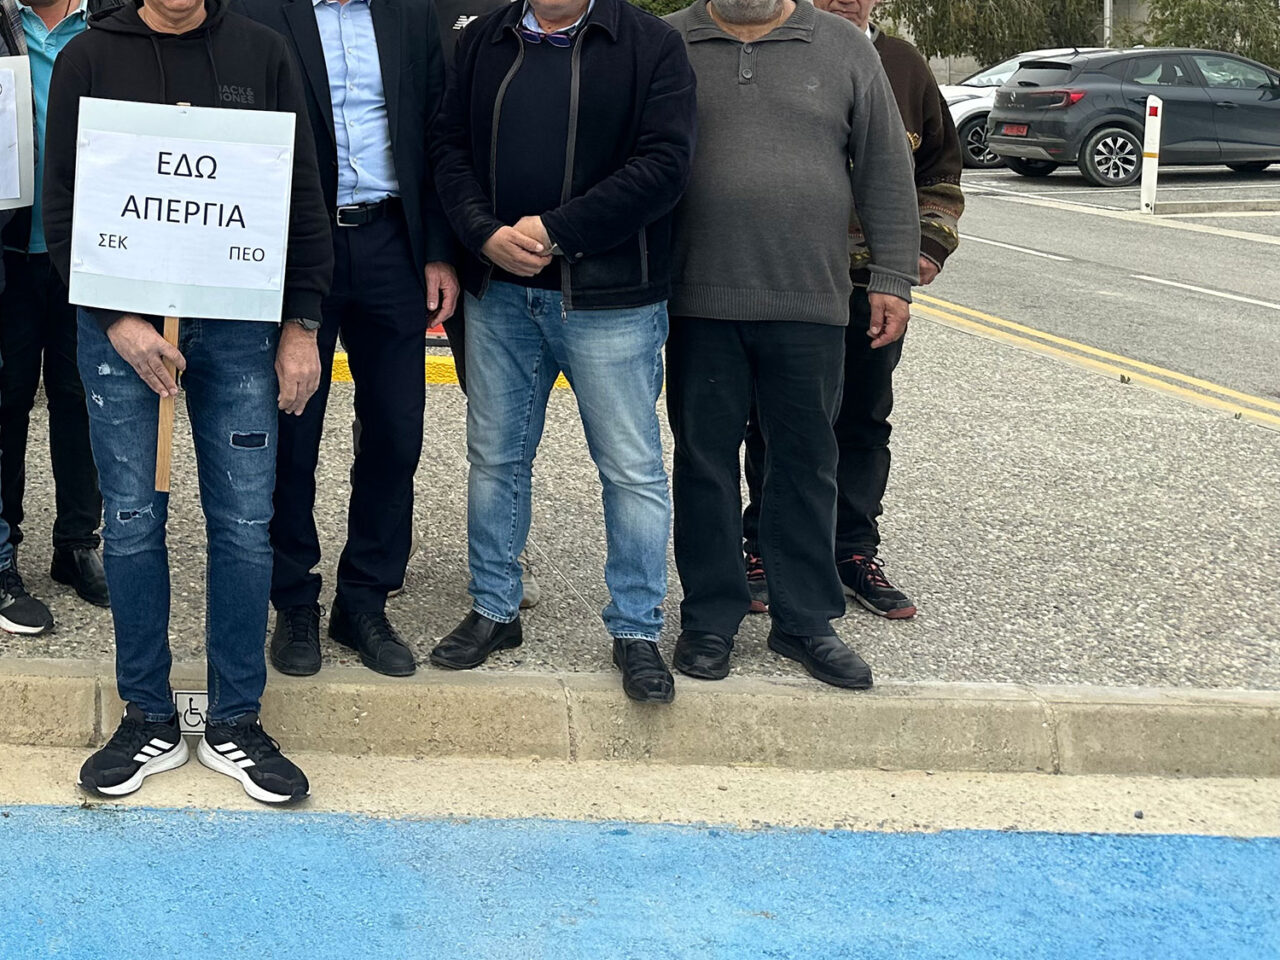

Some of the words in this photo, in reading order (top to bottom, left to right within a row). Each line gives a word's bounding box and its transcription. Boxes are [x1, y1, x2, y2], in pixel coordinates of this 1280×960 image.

[157, 151, 218, 179] ΕΔΩ
[121, 194, 246, 229] ΑΠΕΡΓΙΑ
[98, 232, 129, 250] ΣΕΚ
[229, 246, 266, 262] ΠΕΟ
